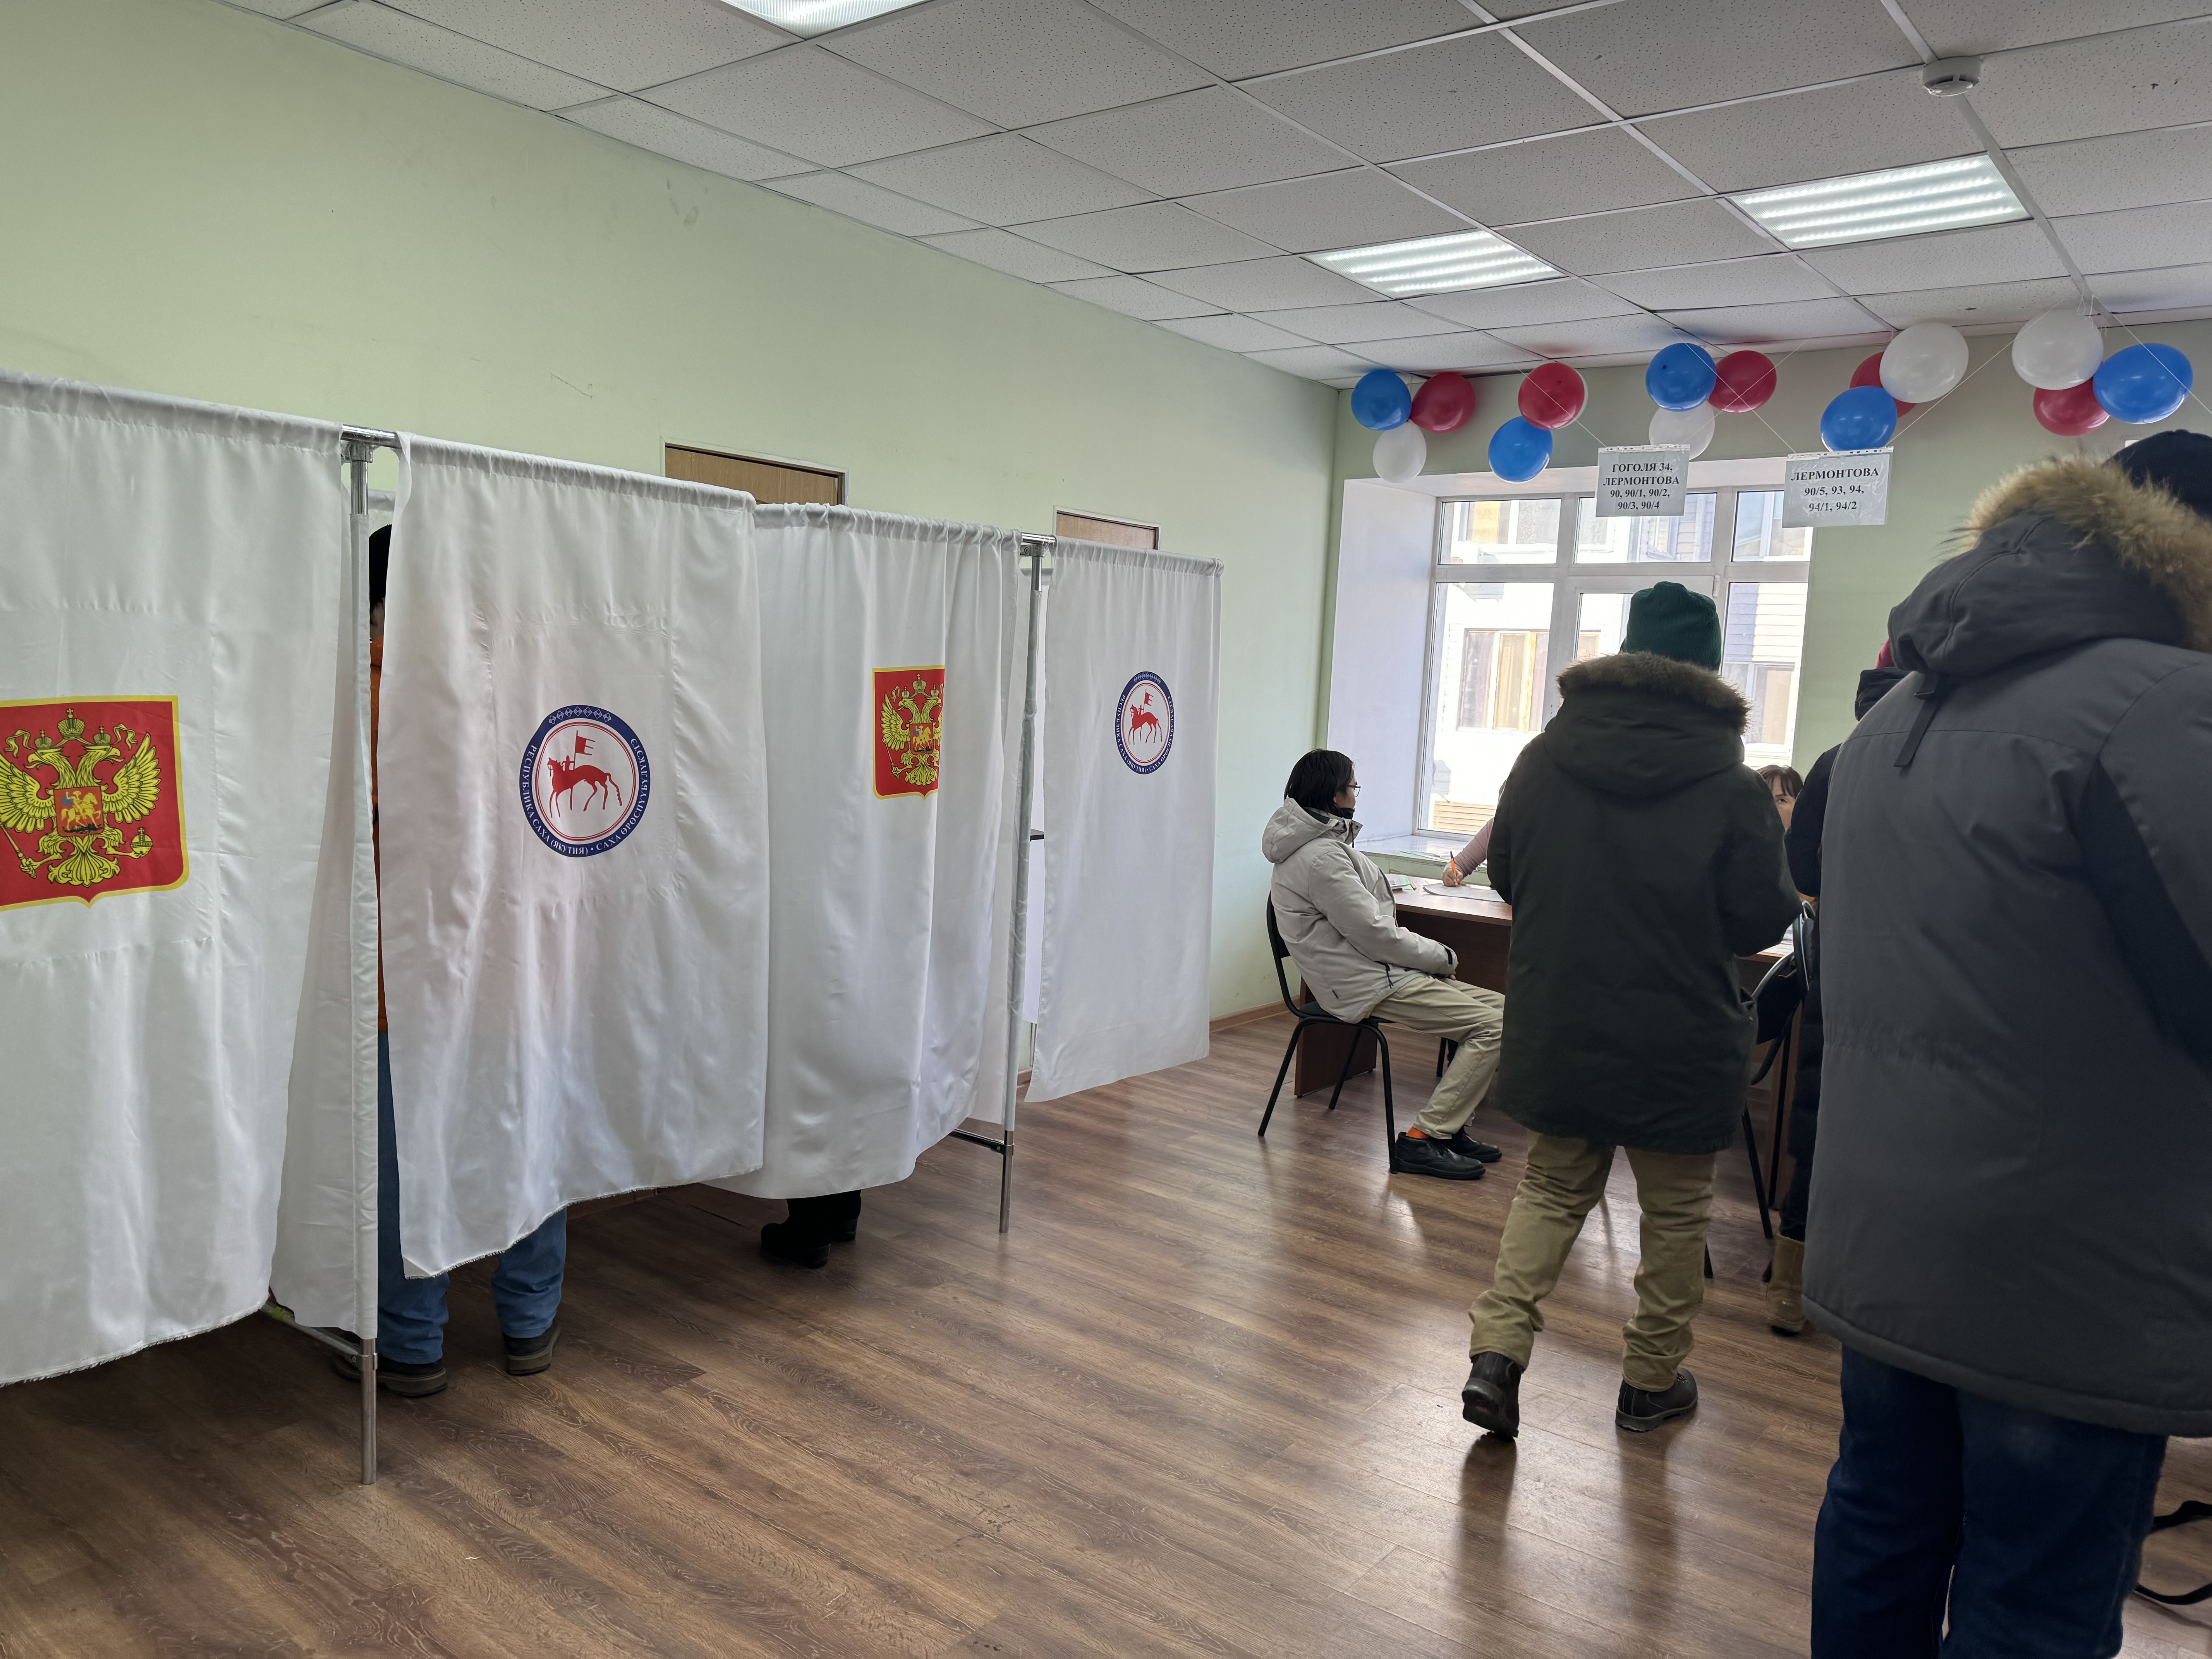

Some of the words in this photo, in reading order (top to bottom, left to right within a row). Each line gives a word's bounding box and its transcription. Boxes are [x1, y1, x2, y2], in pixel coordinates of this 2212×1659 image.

[1612, 463, 1657, 472] ГОГОЛЯ
[1791, 467, 1879, 481] ЛЕРМОНТОВА
[1603, 476, 1680, 486] ЛЕРМОНТОВА
[1610, 489, 1623, 499] 90,
[1625, 489, 1646, 498] 90/1,
[1649, 488, 1670, 498] 90/2,
[1804, 486, 1828, 496] 90/5,
[1831, 486, 1846, 495] 93,
[1849, 484, 1864, 495] 94,
[1618, 501, 1638, 511] 90/3,
[1641, 501, 1659, 510] 90/4
[1808, 502, 1833, 512] 94/1,
[1836, 501, 1857, 511] 94/2
[522, 745, 538, 819] РЕСПУБЛИКА
[532, 819, 550, 843] САХА
[550, 839, 588, 855] (ЯКУТИЯ)
[596, 835, 621, 851] САХА
